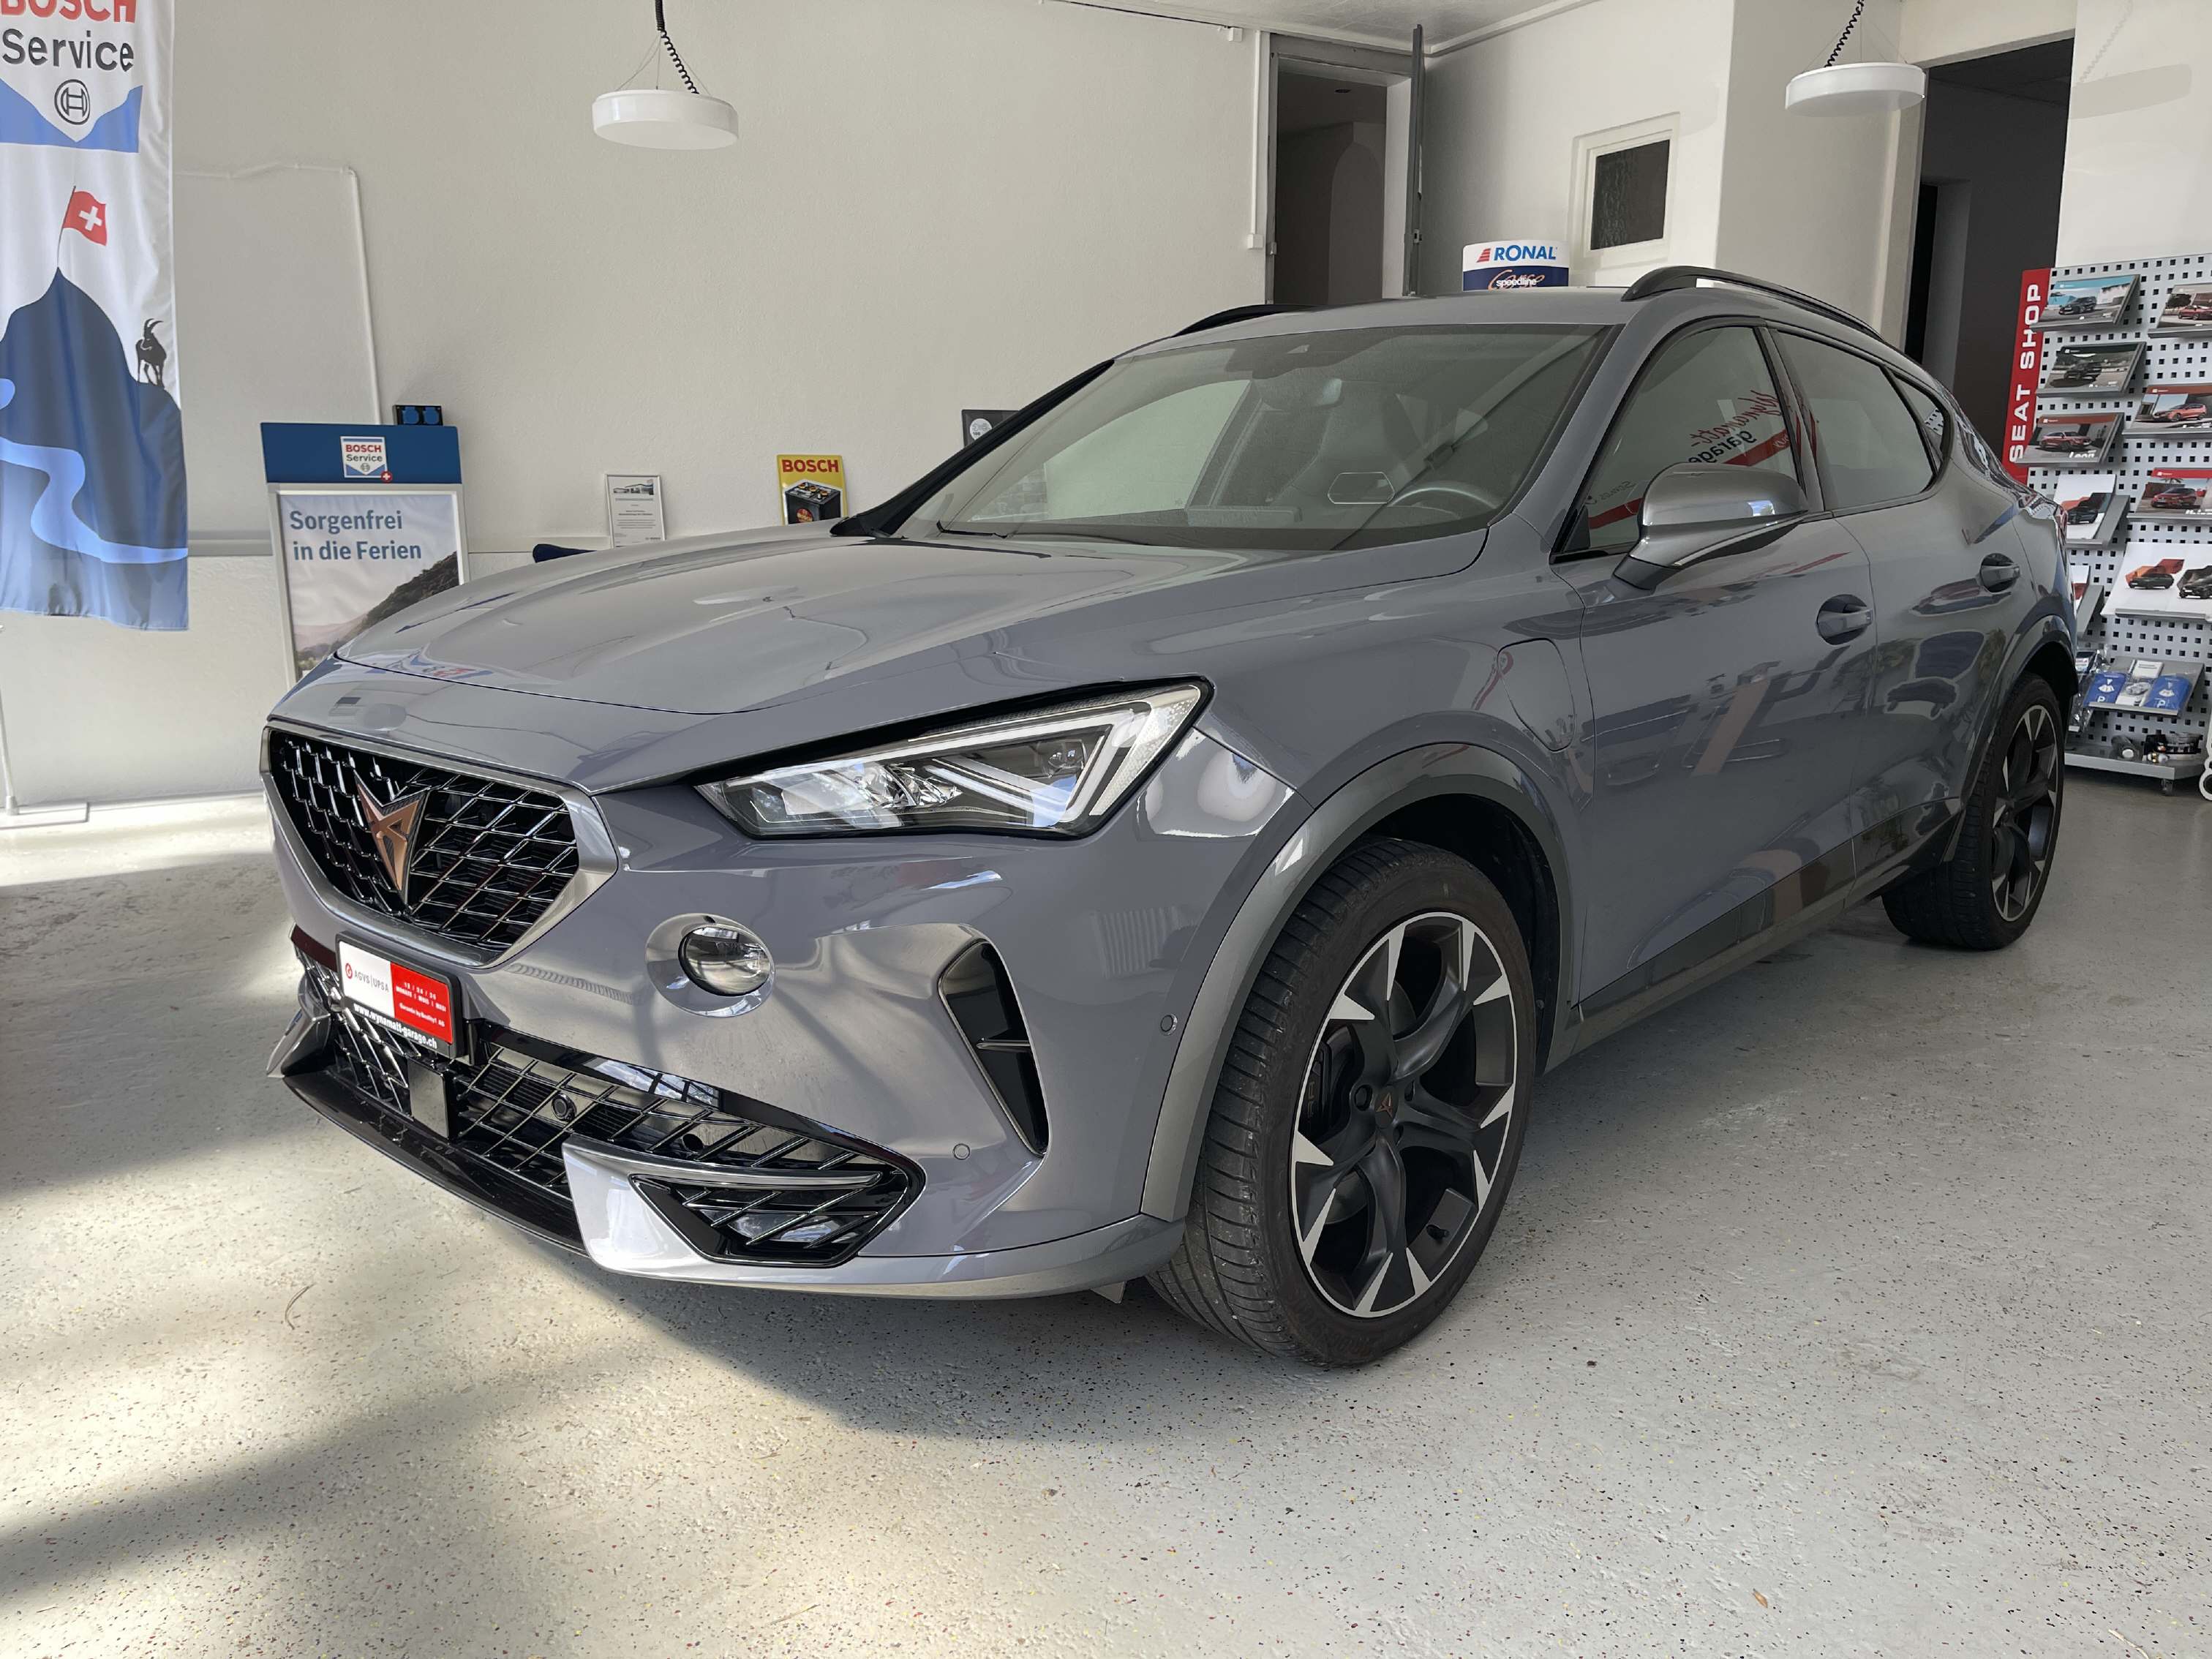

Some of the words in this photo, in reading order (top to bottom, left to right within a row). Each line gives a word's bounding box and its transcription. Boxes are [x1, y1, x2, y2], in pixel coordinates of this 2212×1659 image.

[1, 29, 135, 72] Service
[1494, 244, 1557, 261] RONAL
[2009, 384, 2031, 462] SEAT
[2020, 284, 2042, 369] SHOP
[345, 444, 382, 453] BOSCH
[346, 454, 383, 462] Service
[781, 459, 839, 473] BOSCH
[290, 510, 402, 534] Sorgenfrei
[293, 541, 313, 560] in
[319, 541, 351, 560] die
[356, 541, 422, 560] Ferien
[353, 1003, 437, 1049] www.wynamatt-garage.ch
